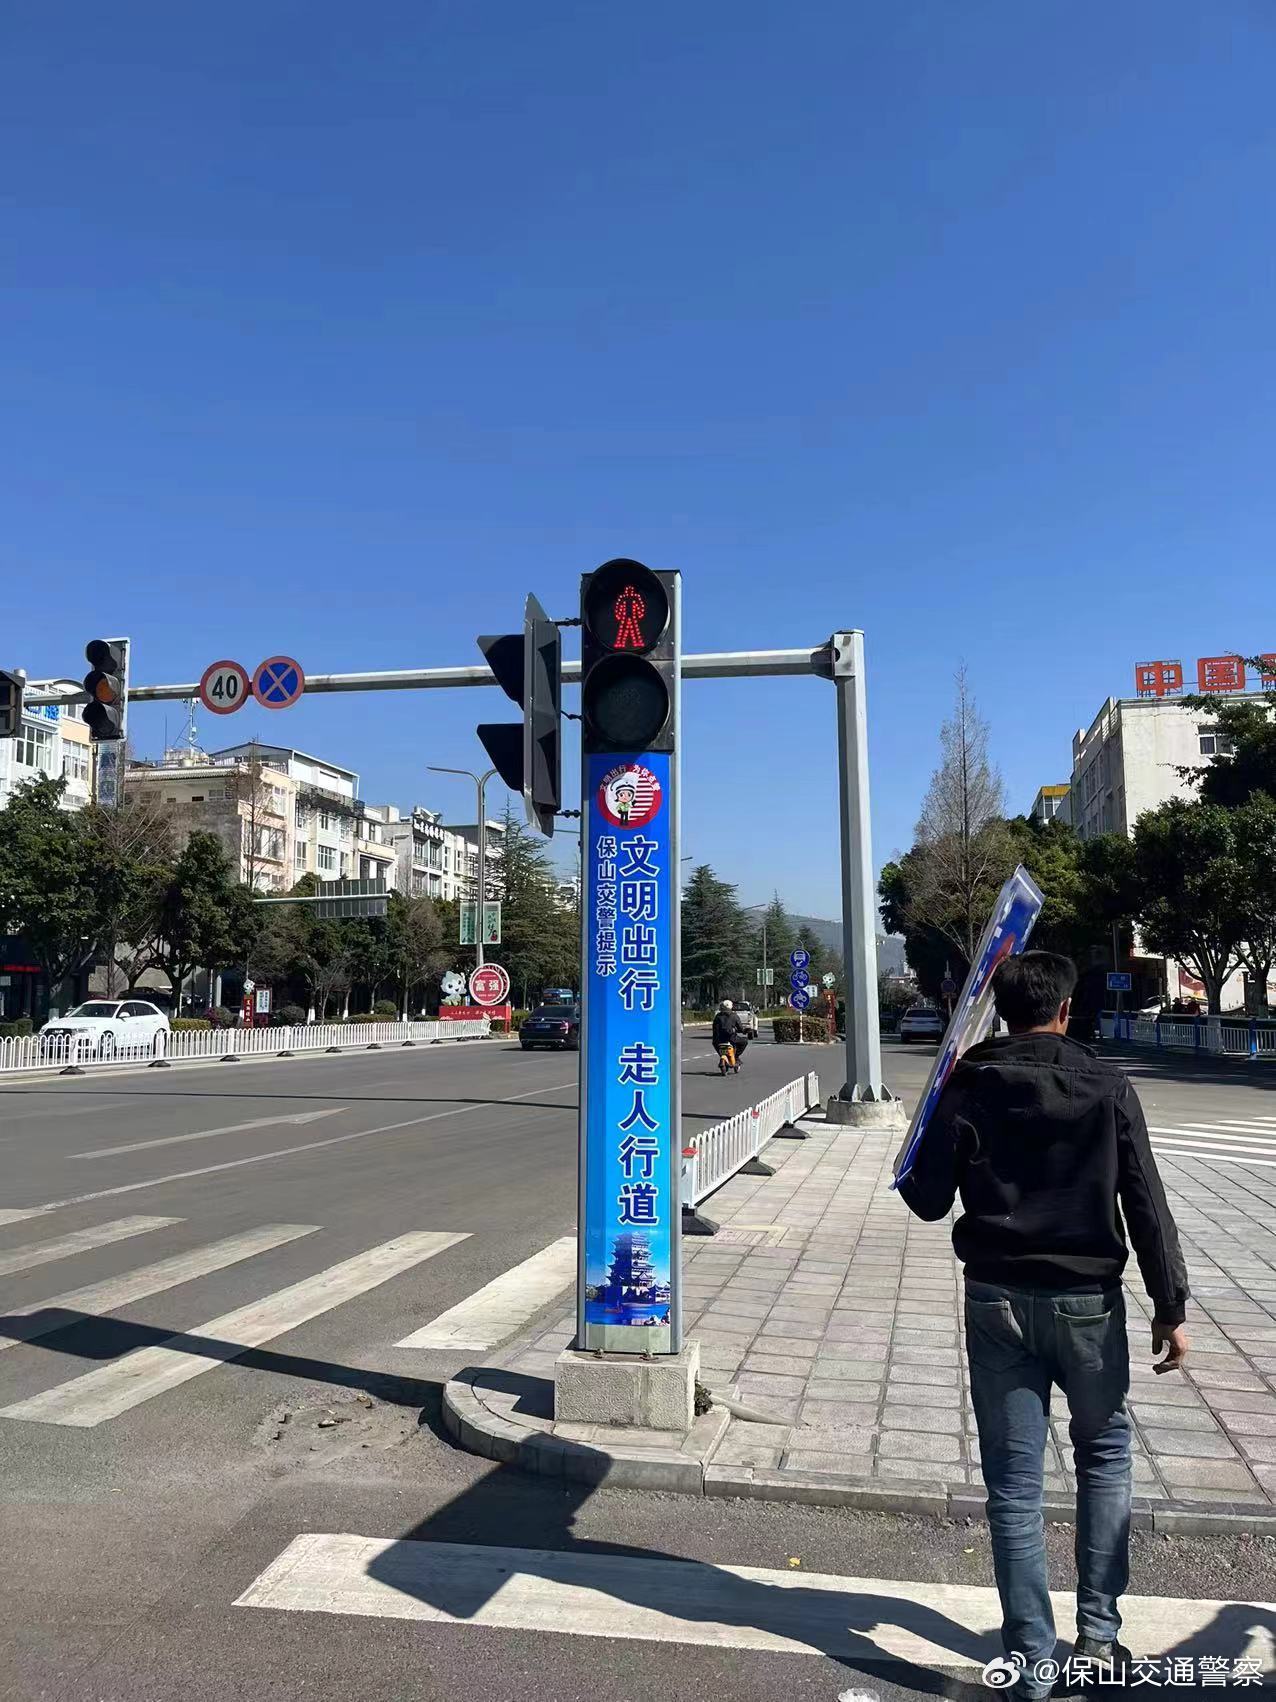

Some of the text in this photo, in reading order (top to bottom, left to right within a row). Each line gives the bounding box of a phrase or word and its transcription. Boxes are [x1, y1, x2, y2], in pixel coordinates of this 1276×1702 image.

[212, 675, 238, 699] 40
[597, 836, 617, 976] 保山交警提示
[475, 980, 500, 992] 富强
[618, 834, 660, 1225] 文明出行 走人行道
